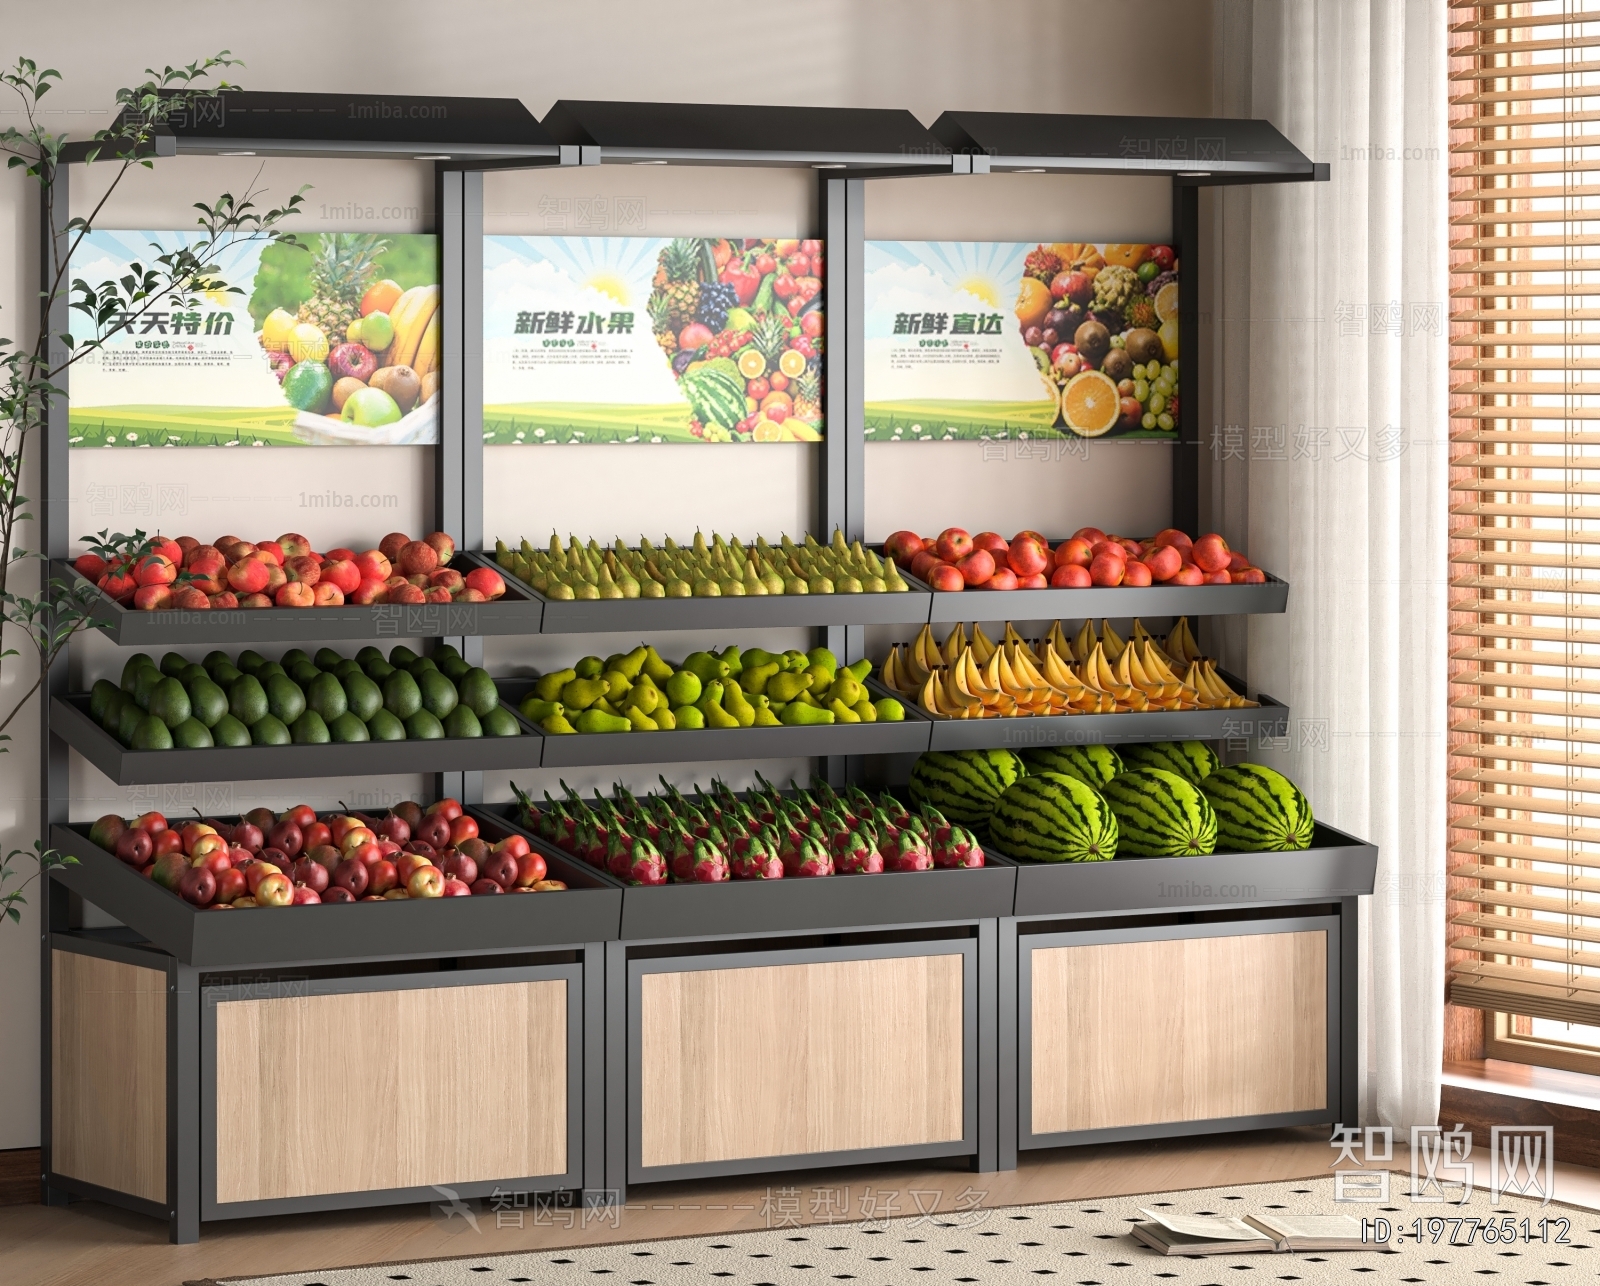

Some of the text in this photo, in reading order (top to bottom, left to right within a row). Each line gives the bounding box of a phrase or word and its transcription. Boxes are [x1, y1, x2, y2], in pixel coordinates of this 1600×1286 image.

[106, 311, 235, 335] 天天特价
[514, 310, 635, 335] 新鲜水果
[893, 312, 1004, 335] 新鲜直达
